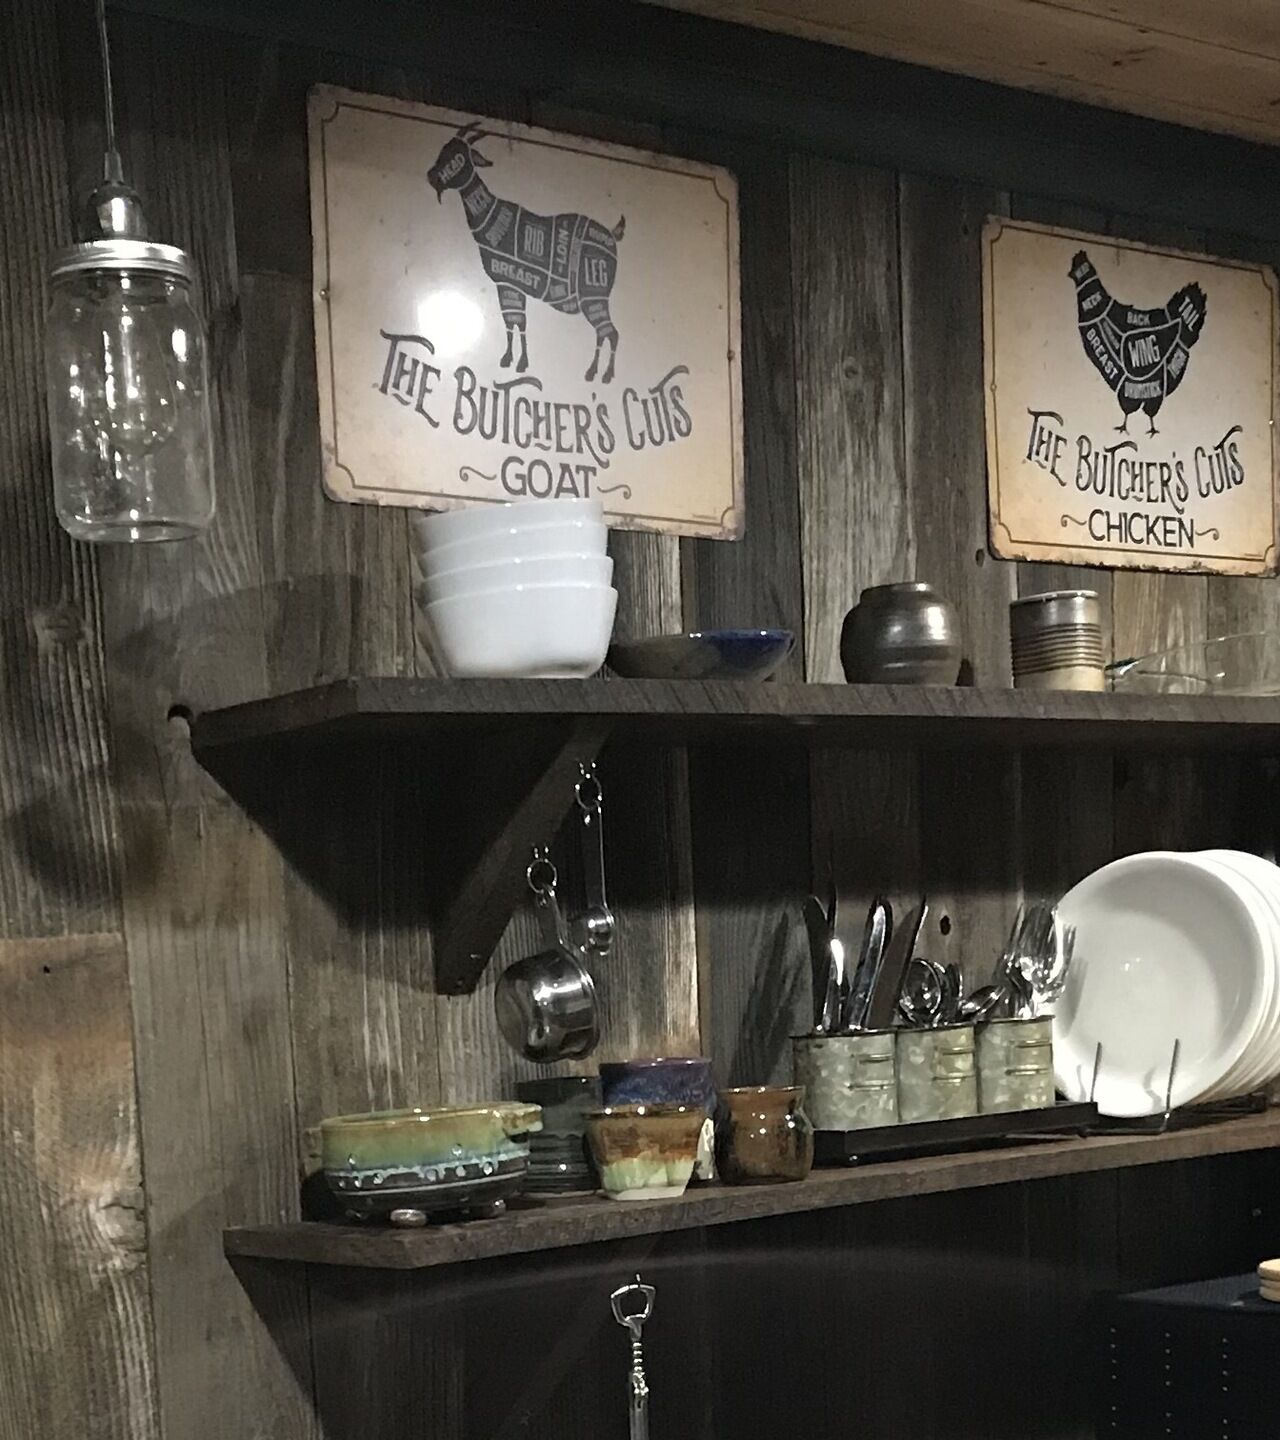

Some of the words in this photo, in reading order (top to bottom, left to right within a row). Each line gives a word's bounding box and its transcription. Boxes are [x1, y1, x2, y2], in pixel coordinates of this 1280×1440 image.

[437, 153, 466, 184] HEAD
[524, 224, 545, 257] RIB
[556, 228, 570, 266] LOIN
[490, 258, 541, 290] BREAST
[584, 256, 609, 288] LEG
[1126, 311, 1151, 326] BACK
[1178, 296, 1200, 332] TAIL
[1086, 328, 1119, 379] BREAST
[1128, 334, 1161, 369] WING
[376, 328, 441, 428] THE
[453, 366, 616, 469] BUTCHER'S
[622, 364, 693, 452] CUTS
[500, 455, 598, 499] GOAT
[1026, 407, 1068, 488] THE
[1075, 434, 1190, 515] BUTCHER'S
[1196, 424, 1245, 499] CUTS
[1087, 508, 1195, 548] CHICKEN
